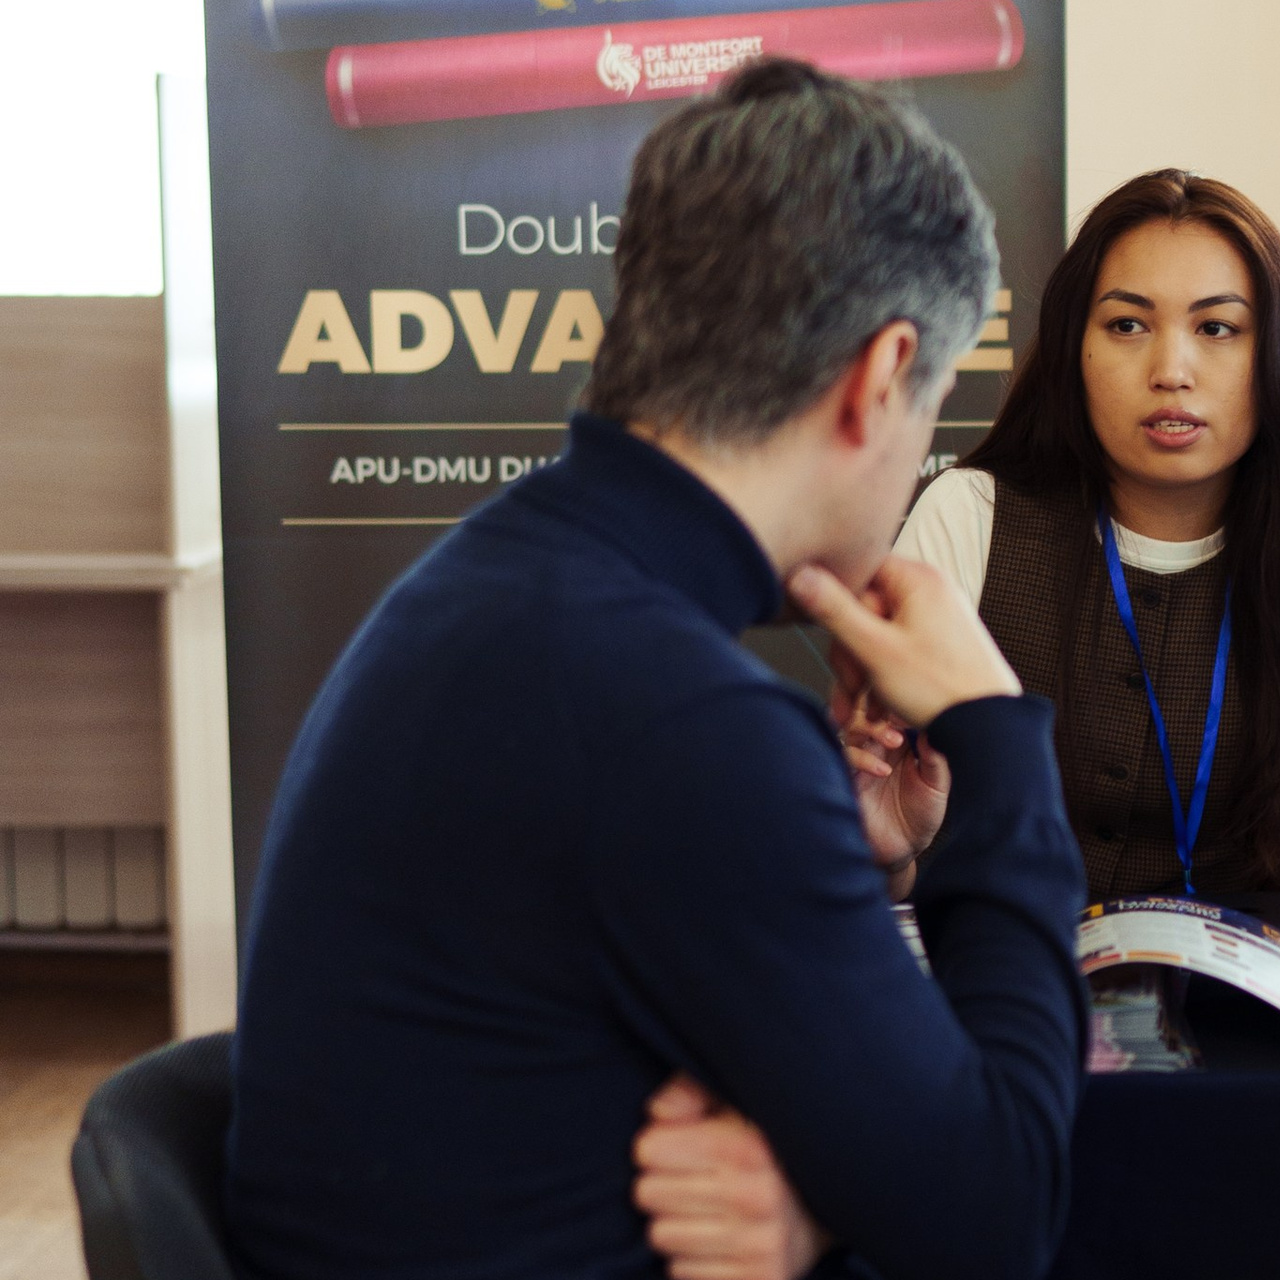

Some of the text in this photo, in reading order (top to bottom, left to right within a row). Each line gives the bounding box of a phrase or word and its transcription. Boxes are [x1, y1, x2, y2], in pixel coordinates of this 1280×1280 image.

[643, 36, 763, 62] DE MONTFORT
[329, 456, 492, 484] APU-DMU
